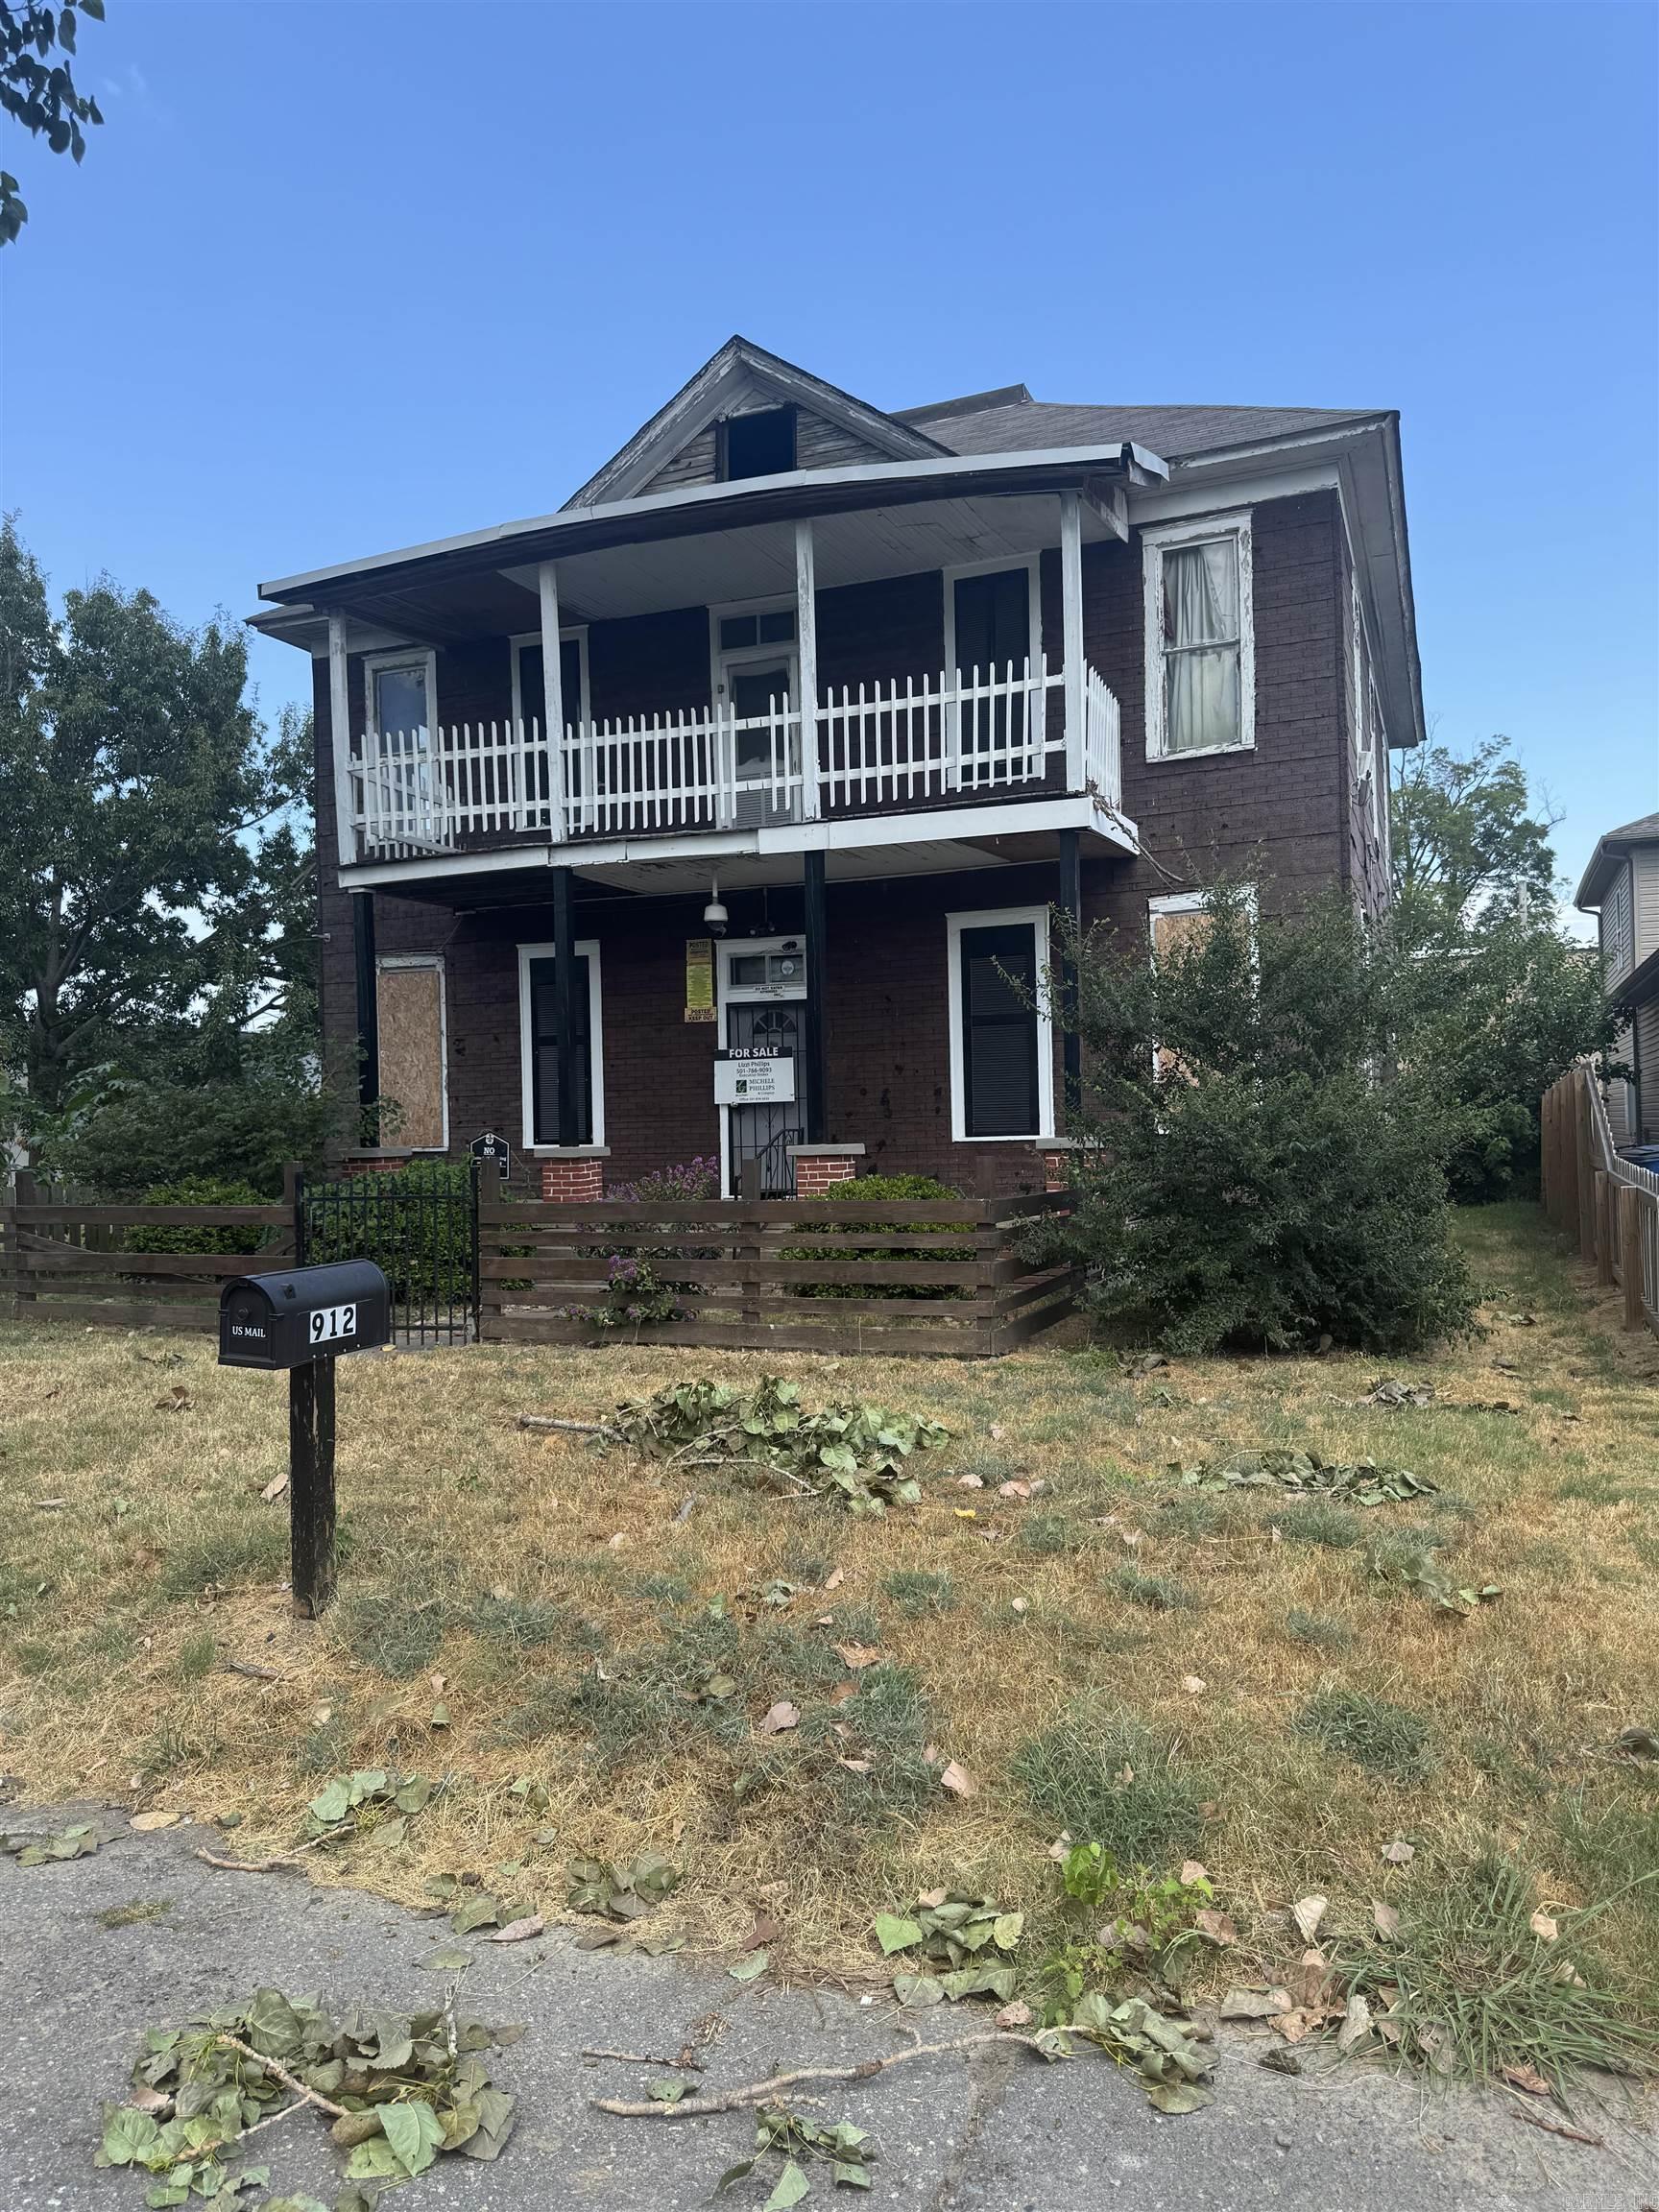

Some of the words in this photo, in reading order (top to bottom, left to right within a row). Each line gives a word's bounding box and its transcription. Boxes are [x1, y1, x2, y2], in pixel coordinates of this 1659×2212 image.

[730, 1048, 751, 1058] FOR
[753, 1046, 779, 1057] SALE
[312, 1307, 354, 1341] 912
[231, 1325, 243, 1335] US
[244, 1327, 266, 1337] MAIL
